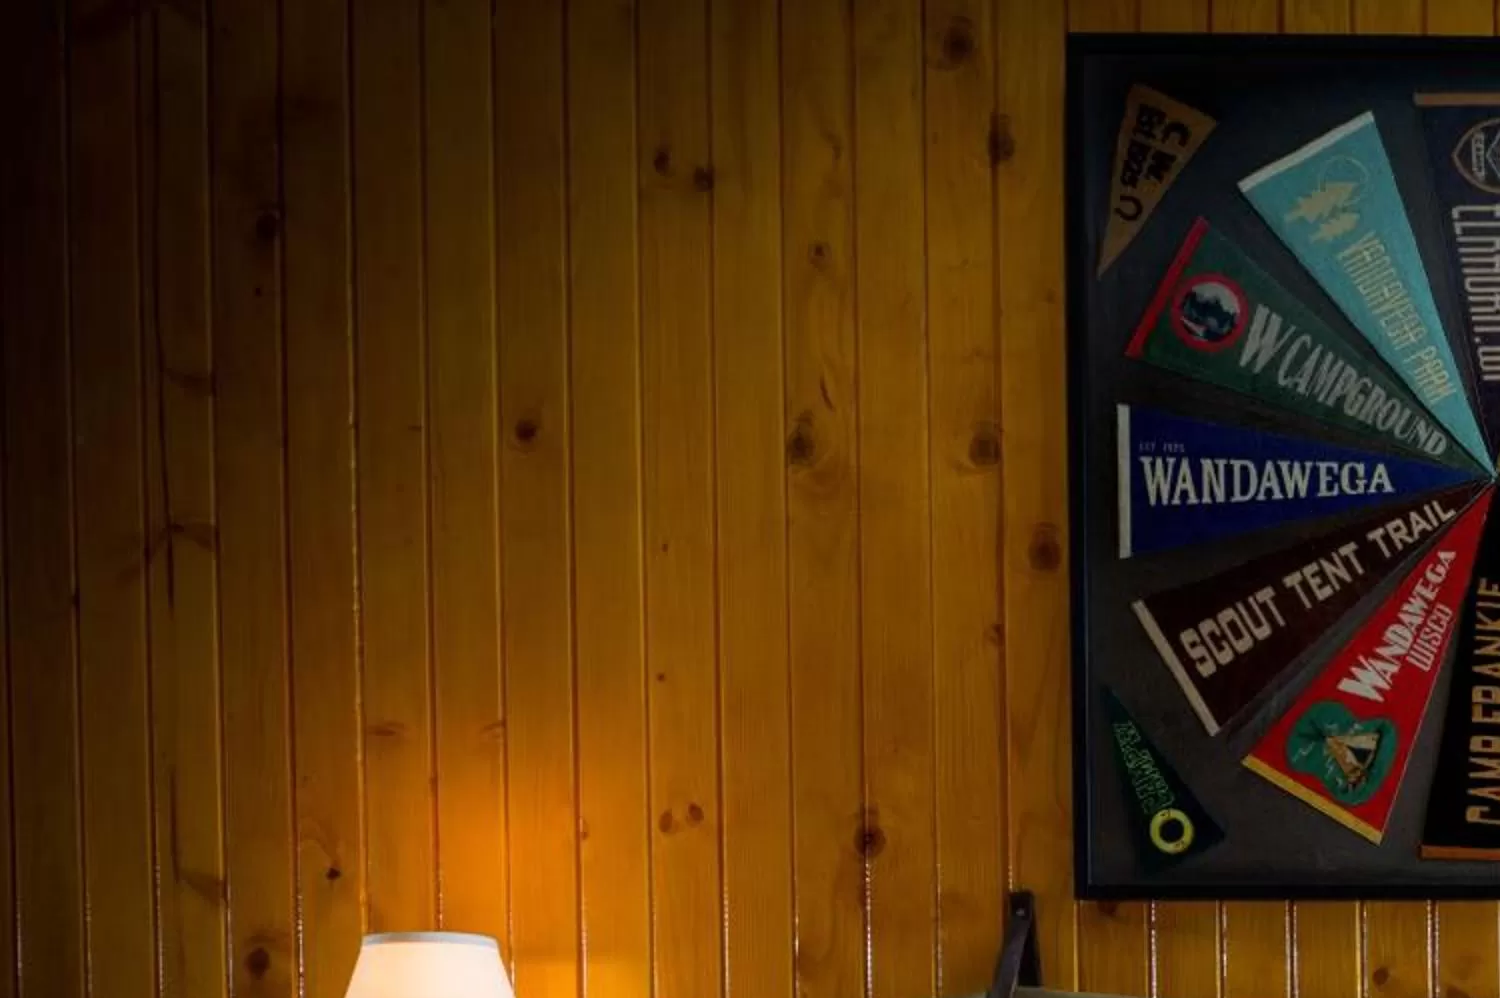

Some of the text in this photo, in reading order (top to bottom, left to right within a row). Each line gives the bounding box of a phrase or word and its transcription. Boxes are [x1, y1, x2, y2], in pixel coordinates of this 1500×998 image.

[1277, 334, 1449, 456] CAMPGROUND
[1138, 455, 1395, 507] WANDAWEGA
[1179, 500, 1458, 679] SCOUT TENT TRAIL
[1336, 549, 1457, 703] WANDAWEGA
[1405, 603, 1454, 673] WISCO
